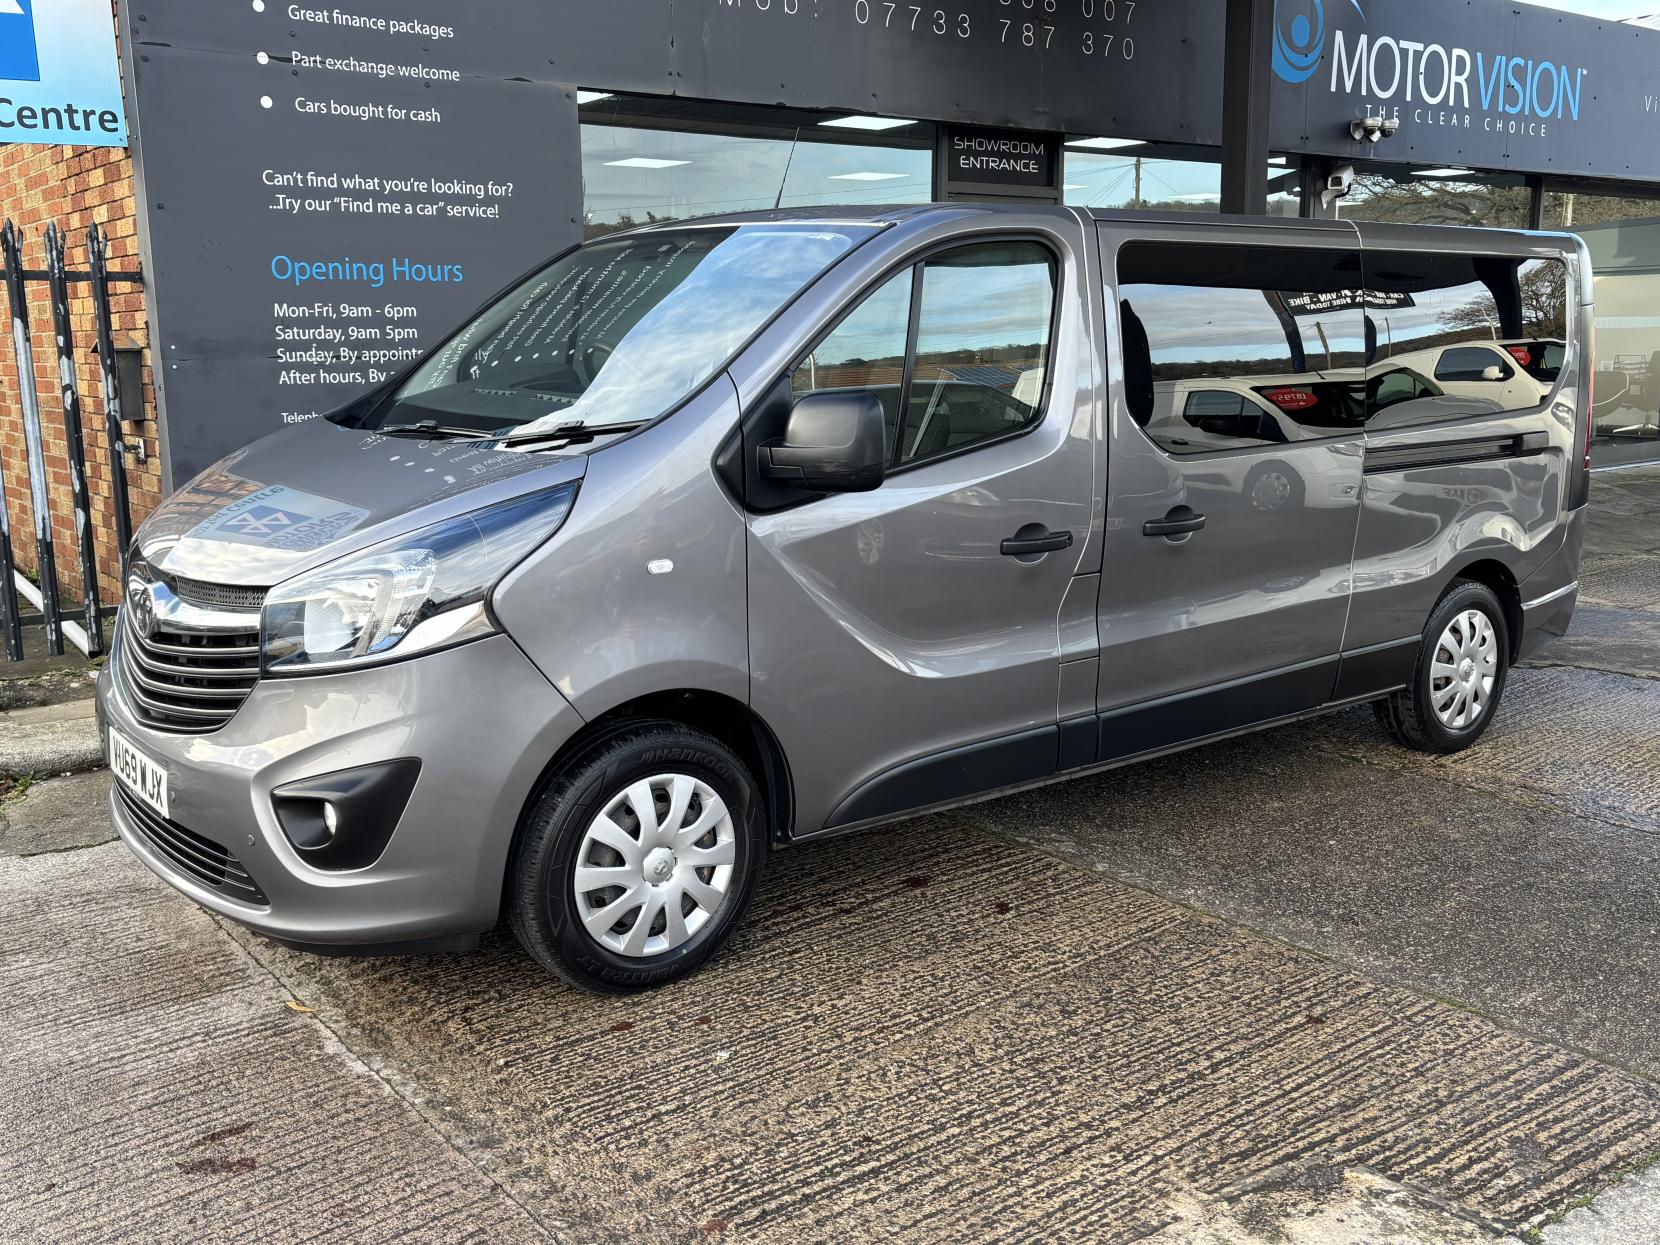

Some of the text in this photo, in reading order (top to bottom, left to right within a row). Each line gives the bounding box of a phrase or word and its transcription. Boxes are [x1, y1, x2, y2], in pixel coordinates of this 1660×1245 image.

[288, 5, 454, 39] Great finance packages
[855, 0, 971, 37] 07733
[1000, 19, 1055, 48] 787
[1082, 32, 1134, 59] 370
[292, 51, 460, 81] Part exchange welcome
[0, 97, 119, 133] Centre
[295, 98, 440, 122] Cars bought for cash
[1366, 104, 1546, 137] THE CLEAR CHOICE
[954, 136, 1044, 155] SHOWROOM
[960, 156, 1039, 172] ENTRANCE
[262, 170, 513, 198] Can't find what you're looking for?
[304, 199, 331, 211] our
[377, 201, 401, 213] me
[405, 203, 412, 214] a
[447, 204, 499, 218] service!
[271, 255, 463, 287] Opening Hours
[274, 303, 337, 319] Mon-Fri,
[340, 303, 372, 317] 9am
[385, 303, 417, 320] 6pm
[275, 325, 417, 343] Saturday, 9am 5pm
[277, 346, 423, 364] Sunday, By appoint
[279, 370, 316, 384] After
[320, 369, 365, 384] hours,
[139, 759, 163, 808] WJX
